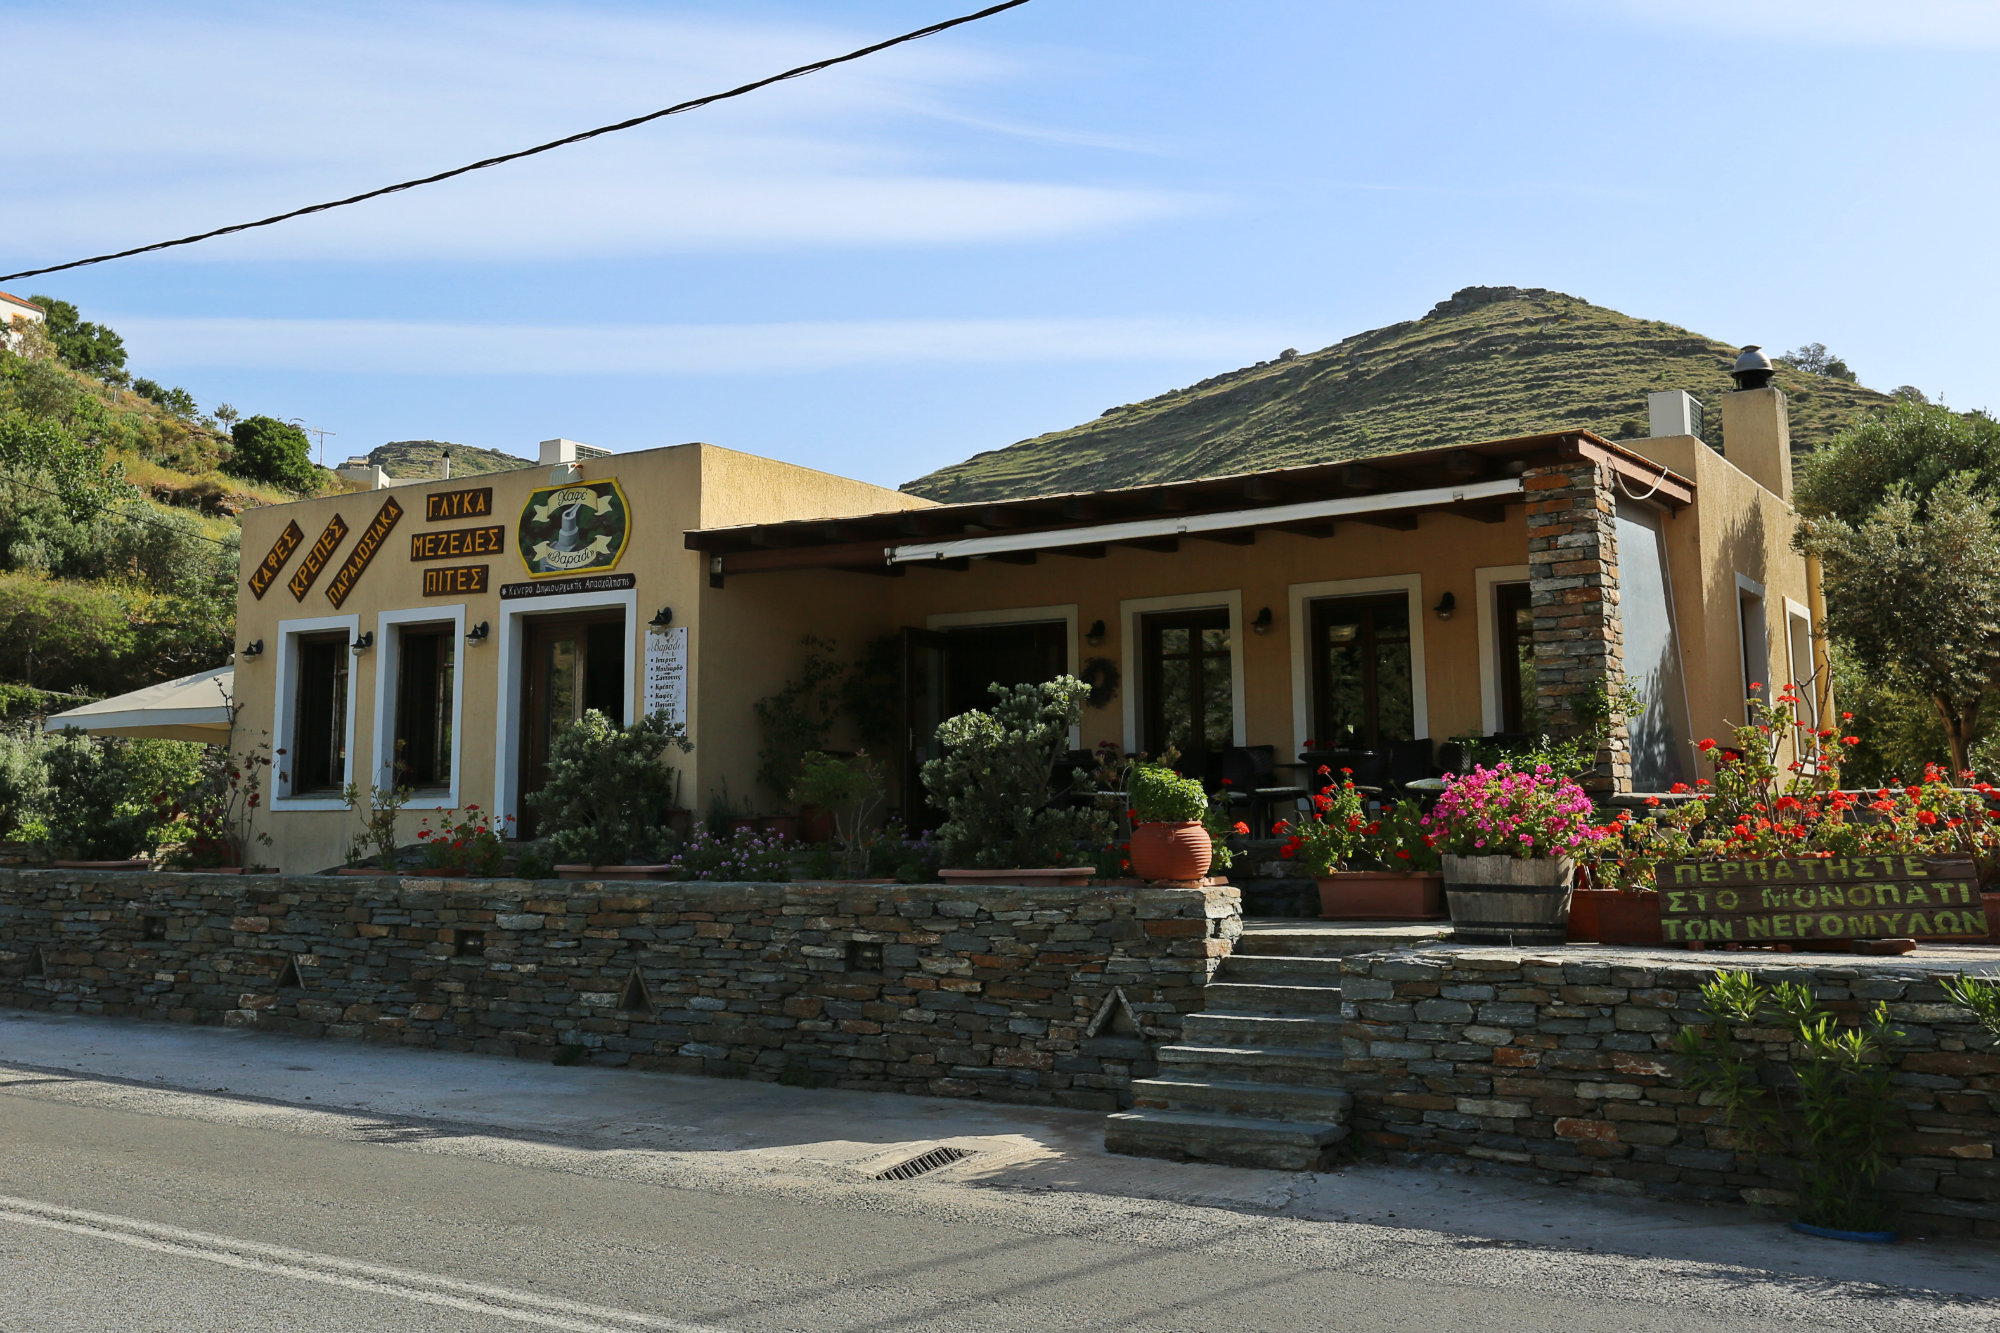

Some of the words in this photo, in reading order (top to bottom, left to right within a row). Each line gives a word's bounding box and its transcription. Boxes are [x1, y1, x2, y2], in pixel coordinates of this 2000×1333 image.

[428, 492, 485, 518] ΓΛΥΚΑ
[290, 518, 344, 597] ΚΡΕΠΕΣ
[328, 505, 399, 604] ΠΑΡΑΔΟΣΙΑΚΑ
[412, 528, 499, 558] ΜΕΖΕΔΕΣ
[252, 528, 297, 593] ΚΑΦΕΣ
[426, 568, 481, 592] ΠΙΤΕΣ
[1674, 855, 1929, 884] ΠΕΡΠΑΤΗΣΤΕ
[1668, 889, 1740, 912] ΣΤΟ
[1761, 882, 1970, 909] ΜΟΝΟΠΑΤΙ
[1661, 919, 1733, 940] ΤΩΝ
[1746, 910, 1988, 936] ΝΕΡΟΜΥΛΩΝ
